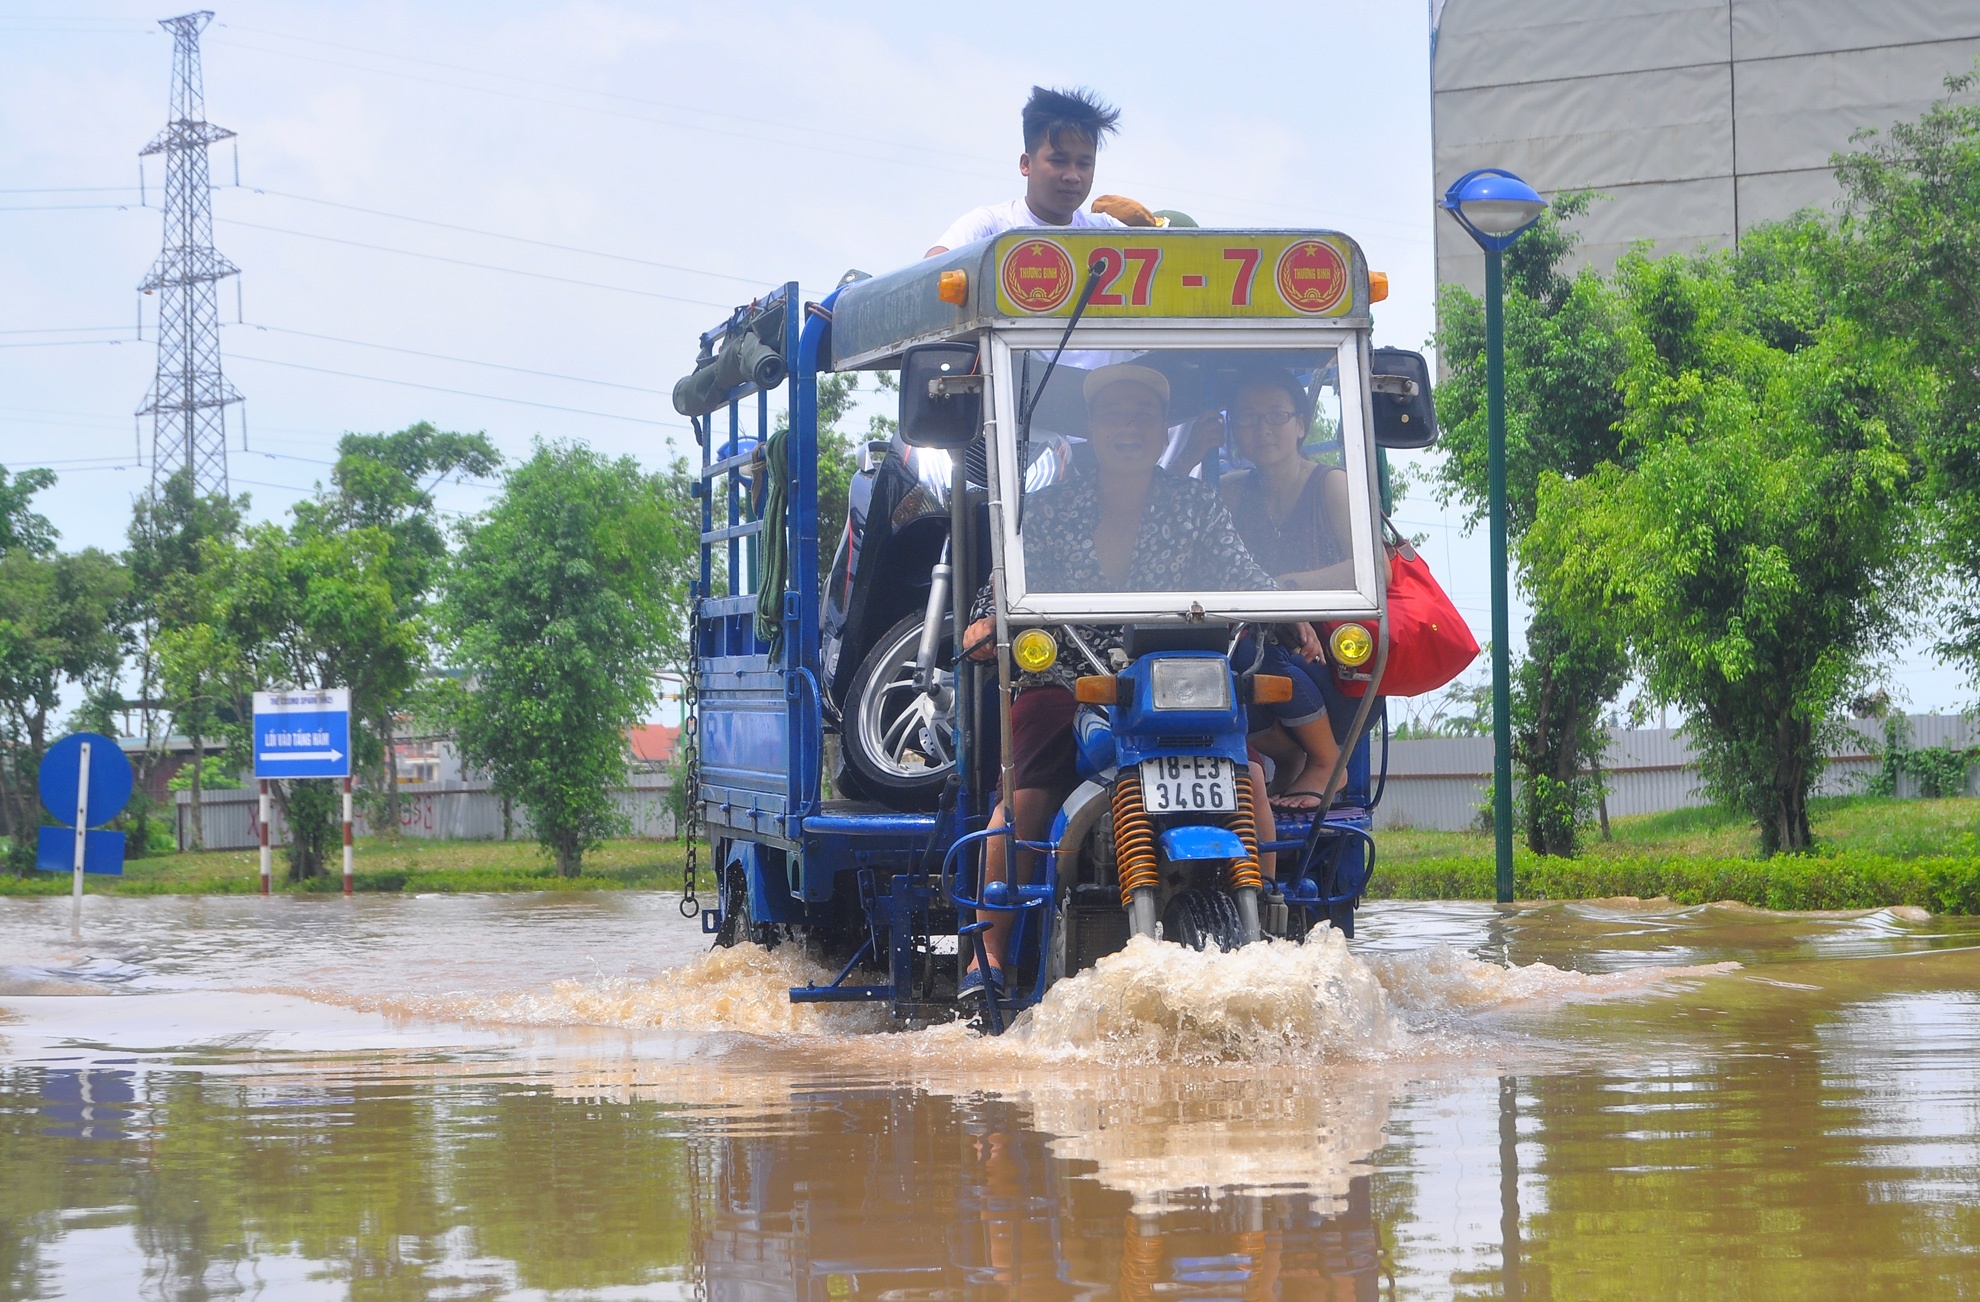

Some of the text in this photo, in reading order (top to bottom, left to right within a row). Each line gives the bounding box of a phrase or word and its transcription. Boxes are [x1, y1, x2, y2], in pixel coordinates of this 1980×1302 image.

[1086, 246, 1164, 306] 27
[1223, 247, 1264, 306] 7
[1158, 755, 1220, 780] 18-E3
[1156, 782, 1223, 809] 3466
